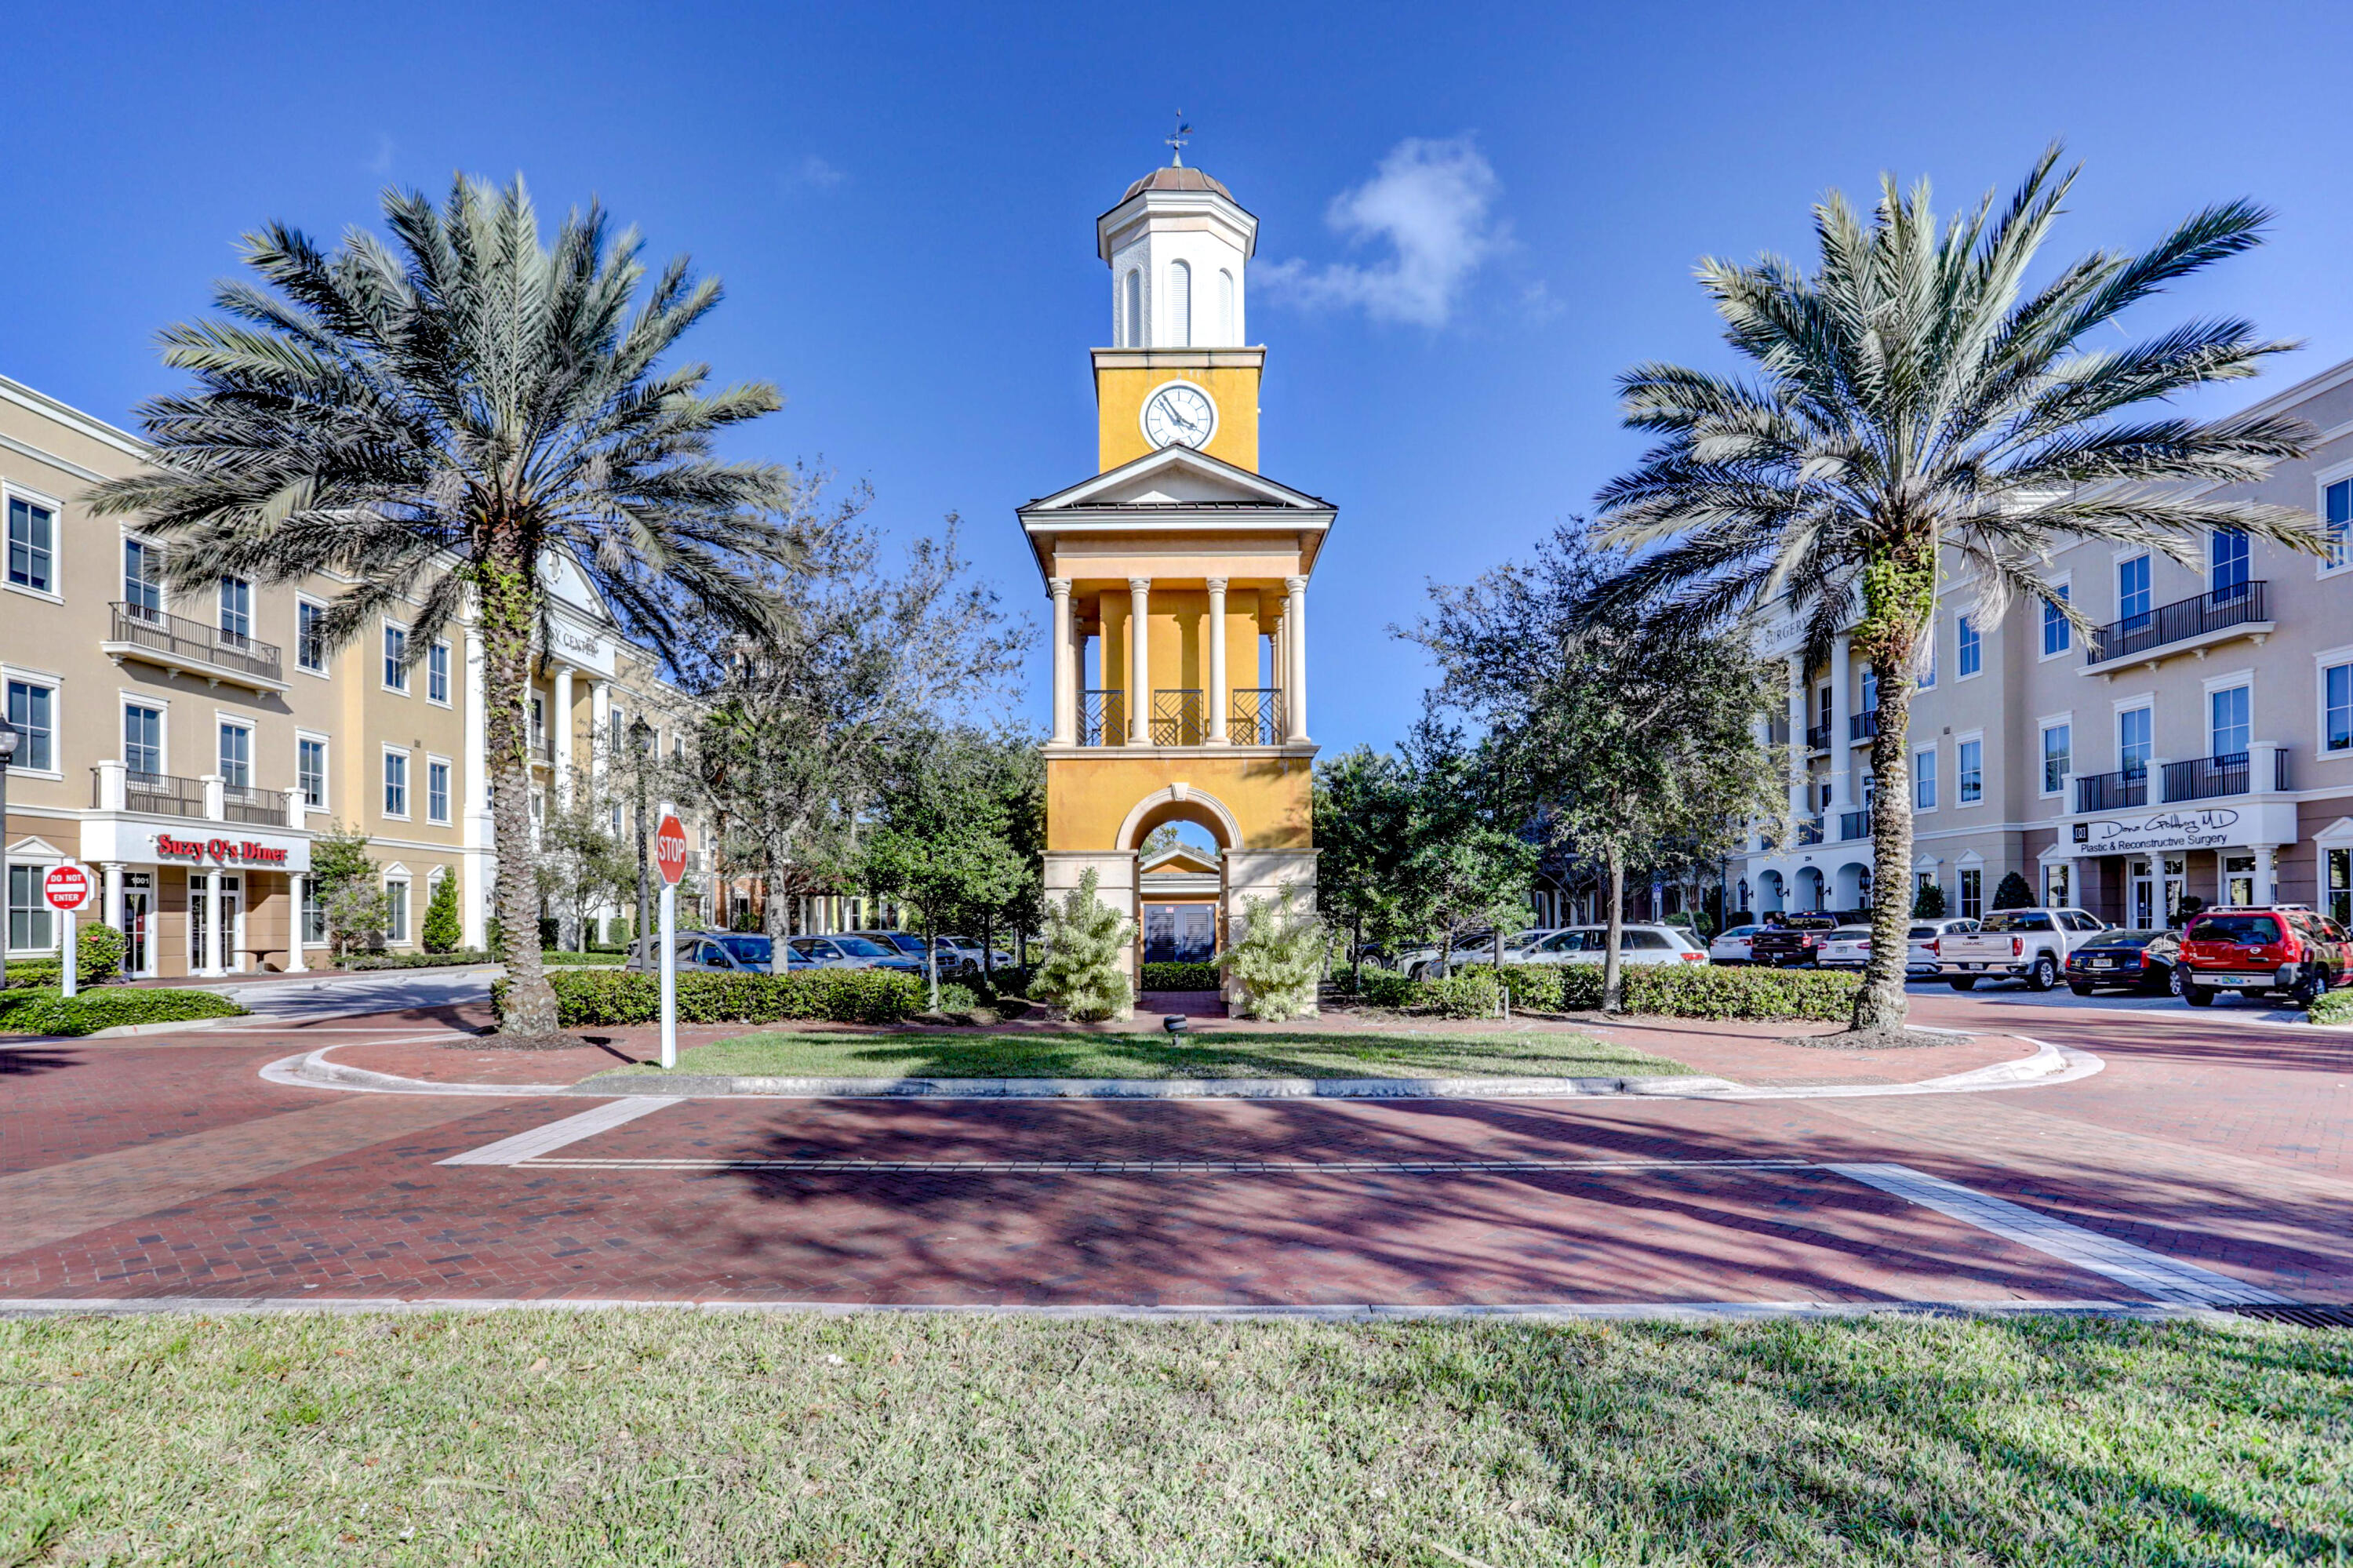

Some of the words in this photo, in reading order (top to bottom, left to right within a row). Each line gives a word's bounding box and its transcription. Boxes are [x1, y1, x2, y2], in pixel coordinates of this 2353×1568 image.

[158, 834, 205, 860] Suzy
[209, 838, 239, 861] Q's
[240, 841, 288, 861] Diner
[659, 835, 685, 863] STOP
[2080, 840, 2108, 853] Plastic
[2109, 841, 2116, 851] &
[2118, 836, 2185, 850] Reconstructive
[2188, 833, 2228, 846] Surgery
[50, 874, 62, 882] DO
[66, 873, 82, 882] NOT
[53, 893, 79, 902] ENTER
